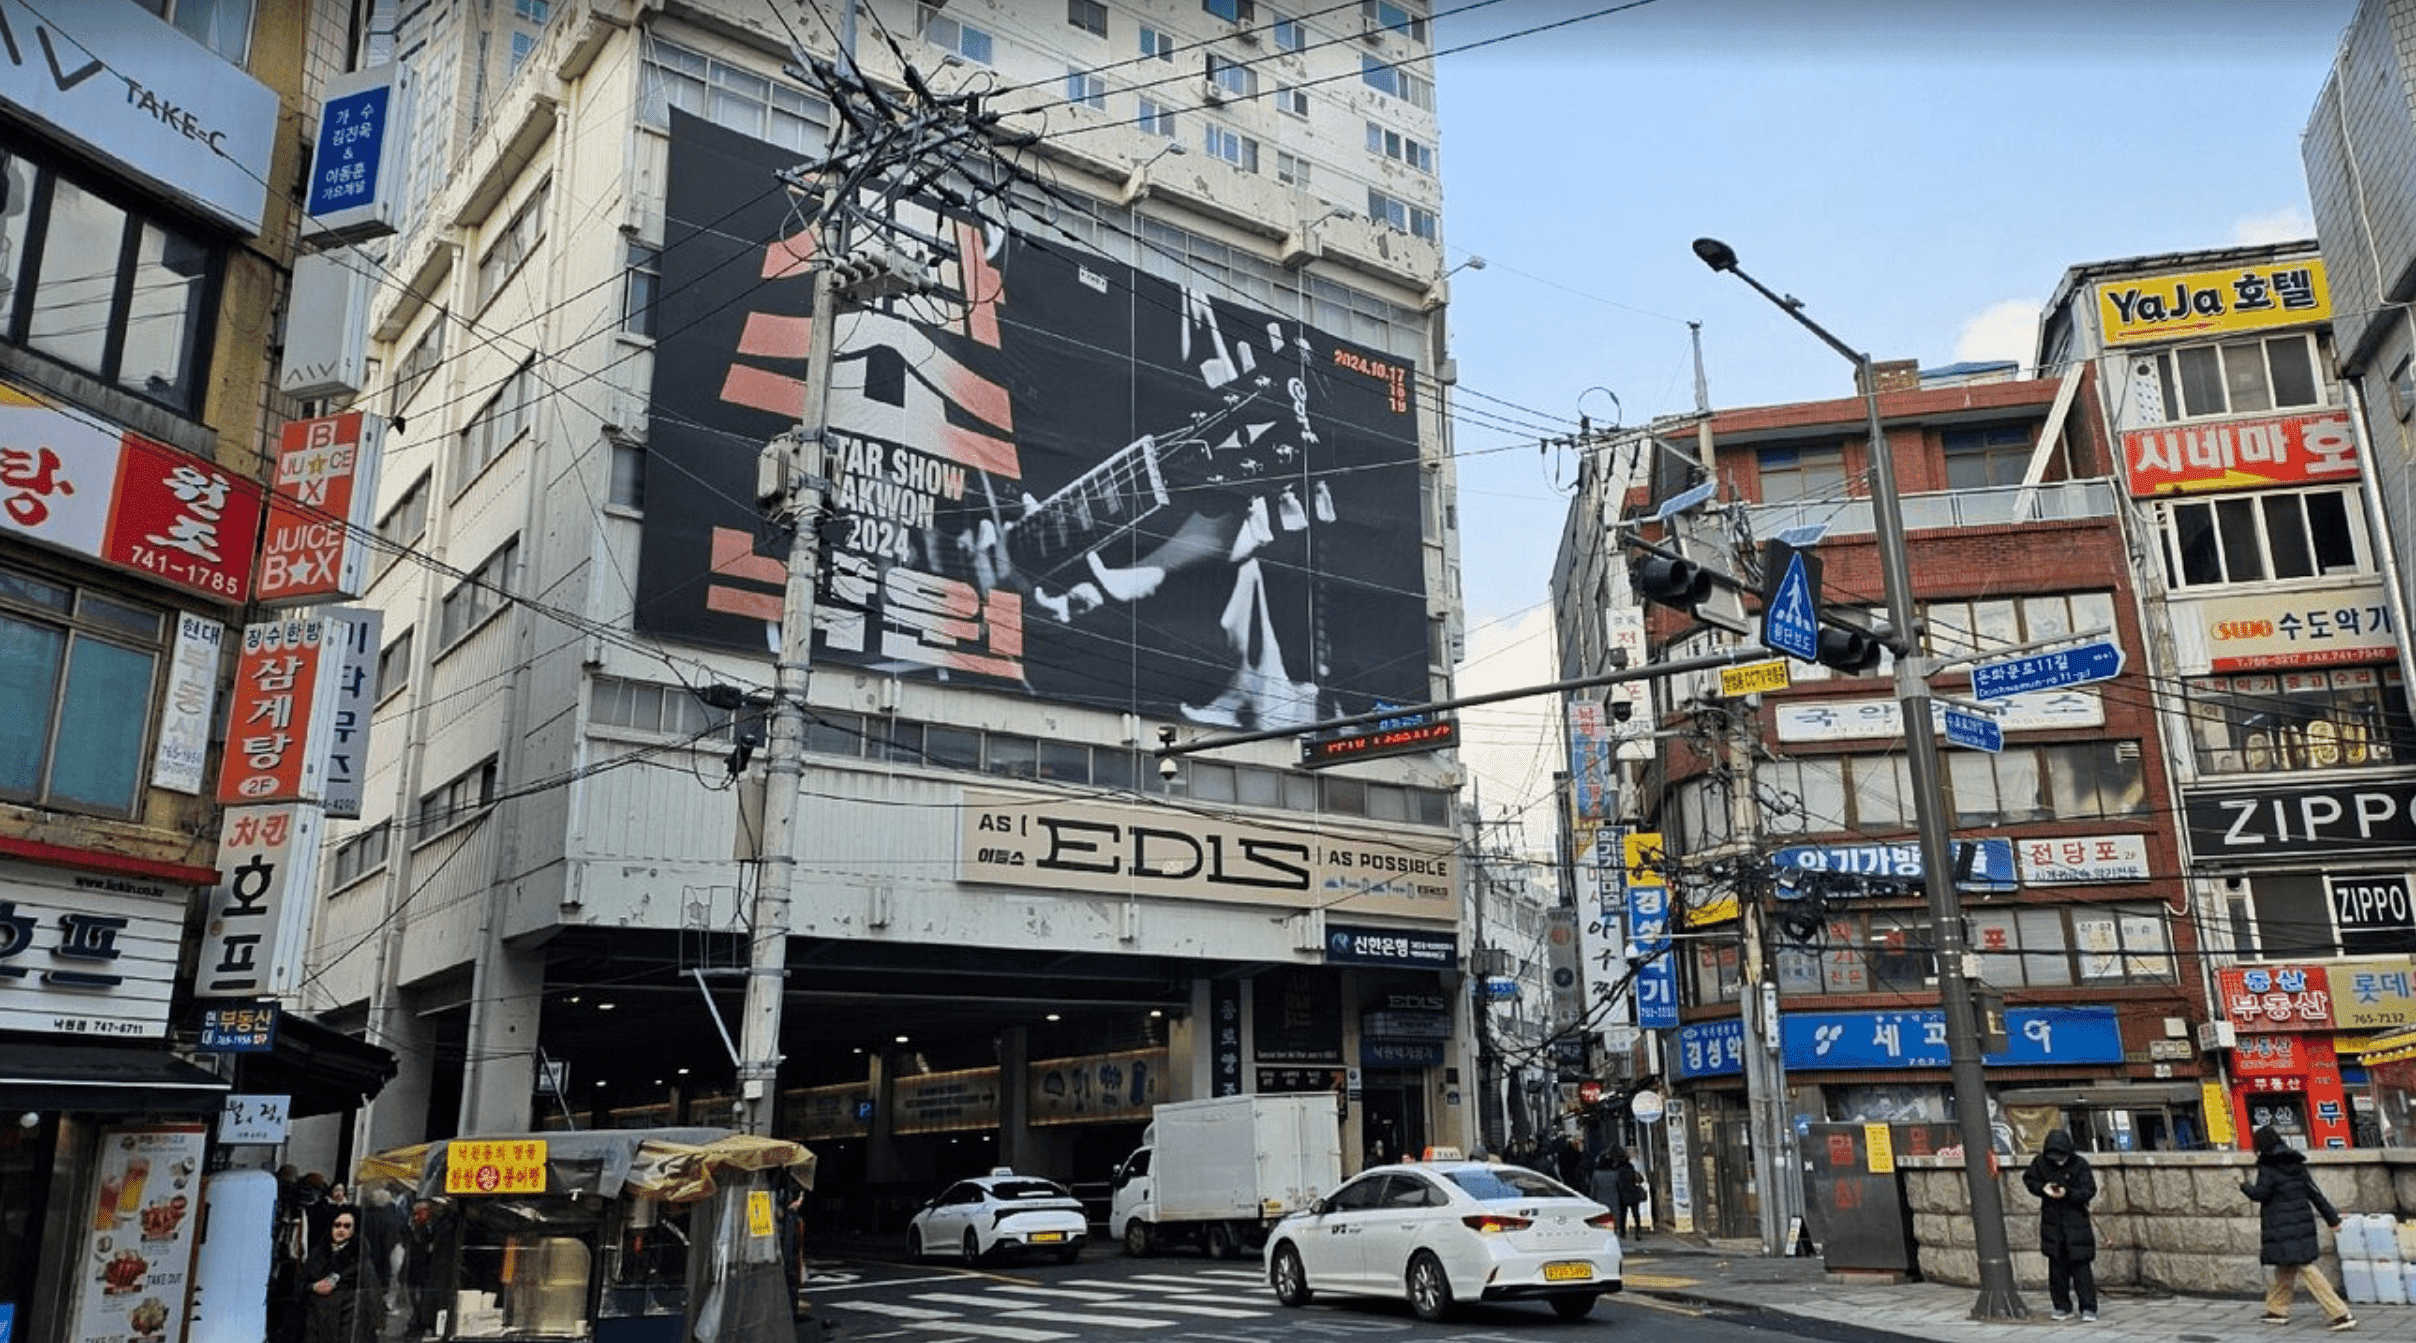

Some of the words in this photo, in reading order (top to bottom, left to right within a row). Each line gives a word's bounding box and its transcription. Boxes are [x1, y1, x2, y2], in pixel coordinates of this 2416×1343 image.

[124, 76, 228, 157] TAKE-C
[342, 146, 354, 160] &
[2107, 284, 2224, 323] YaJa
[2232, 269, 2320, 311] 호텔
[1334, 349, 1405, 382] 2024.10.17
[2135, 421, 2290, 474] 시네마
[892, 448, 965, 501] SHOW
[144, 463, 231, 564] 원조
[839, 474, 934, 530] AKWON
[272, 524, 342, 557] JUICE
[847, 515, 911, 562] 2024
[131, 545, 239, 595] 741-1785
[183, 618, 221, 645] 현대
[2279, 605, 2393, 641] 수도악기
[1976, 654, 2069, 686] 돈화문로11길
[242, 656, 305, 770] 삼계탕
[247, 777, 273, 794] 2F
[228, 812, 290, 849] 치킨
[979, 813, 1012, 833] AS
[1328, 849, 1353, 867] AS
[1360, 852, 1448, 877] POSSIBLE
[2030, 840, 2120, 867] 전당포
[209, 854, 274, 991] 호프
[2335, 885, 2407, 923] ZIPPO
[1354, 935, 1409, 958] 신한은행
[2231, 990, 2329, 1022] 부동산
[2352, 971, 2411, 1005] 롯데
[219, 1008, 274, 1033] 부동산
